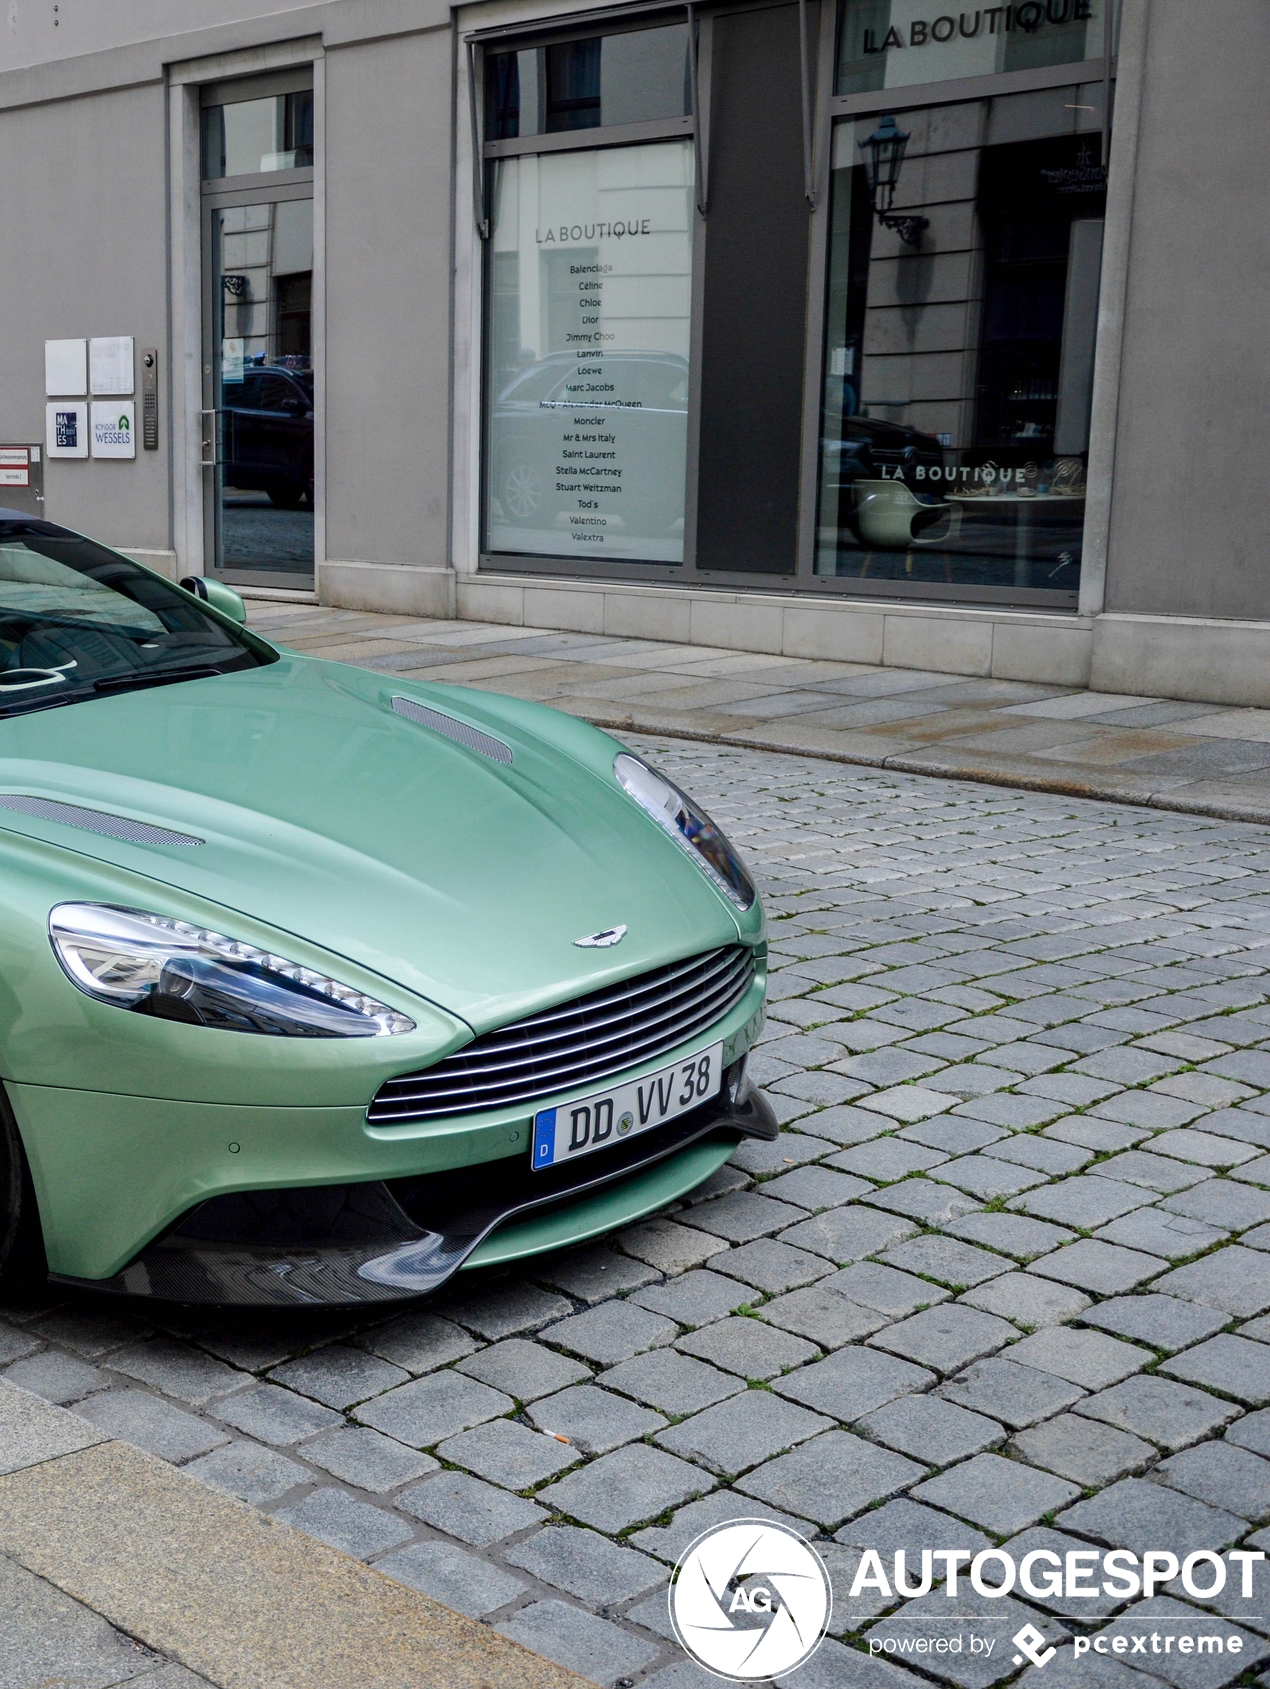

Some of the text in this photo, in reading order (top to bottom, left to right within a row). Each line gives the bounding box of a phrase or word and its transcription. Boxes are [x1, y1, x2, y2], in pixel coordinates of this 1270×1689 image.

[862, 0, 1093, 54] LA BOUTIQUE
[535, 219, 651, 244] LA BOUTIQUE
[570, 263, 613, 274] Balenciaga
[582, 315, 599, 324] Dior
[566, 332, 615, 342] Jimmy Choo
[577, 350, 604, 358] Lanvin
[577, 367, 602, 375] Loewe
[146, 373, 153, 389] 2
[566, 383, 615, 392] Marc Jacobs
[573, 417, 606, 425] Moncler
[95, 423, 116, 431] KONDOR
[95, 432, 131, 444] WESSELS
[563, 433, 616, 443] Mr & Mrs Italy
[562, 450, 616, 459] Saint Laurent
[555, 466, 622, 477] Stella McCartney
[881, 465, 1026, 484] LA BOUTIQUE
[555, 482, 622, 493] Stuart Weitzman
[569, 515, 607, 526] Valentino
[571, 532, 604, 542] Valextra
[540, 1054, 711, 1157] D DD VV 38
